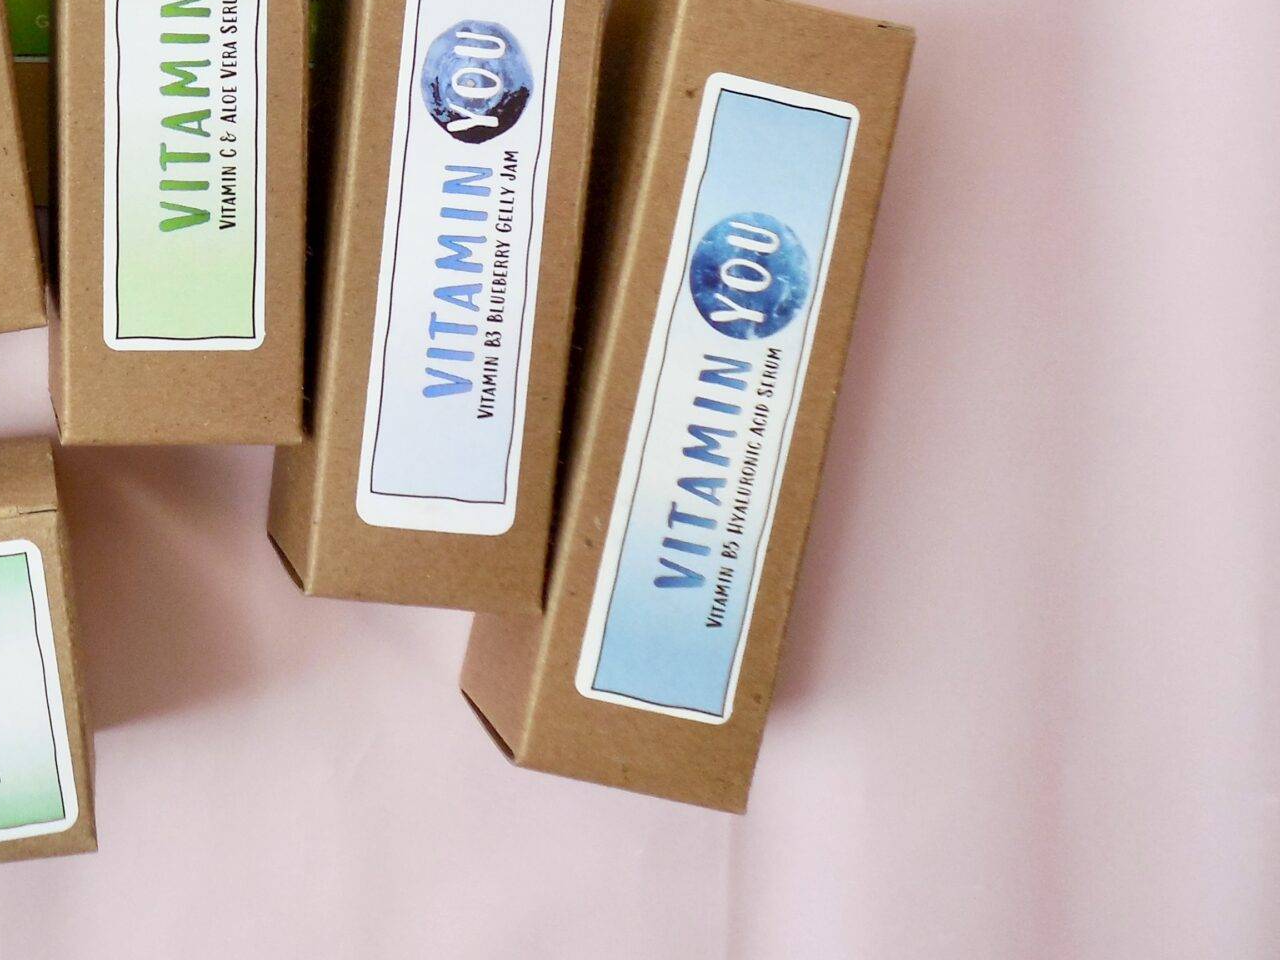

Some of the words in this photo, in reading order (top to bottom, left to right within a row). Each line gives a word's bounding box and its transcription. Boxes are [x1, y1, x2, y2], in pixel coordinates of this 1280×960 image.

[221, 40, 237, 79] VERA
[447, 32, 507, 132] YOU
[221, 84, 237, 124] ALOE
[220, 129, 236, 143] &
[220, 146, 237, 158] C
[499, 150, 519, 182] JAM
[219, 165, 237, 230] VITAMIN
[495, 186, 516, 232] GELLY
[422, 165, 493, 398] VITAMIN
[487, 238, 511, 323] BLUEBERRY
[484, 330, 501, 347] B3
[477, 355, 499, 419] VITAMIN
[757, 347, 782, 397] SERUM
[653, 354, 752, 588] VITAMIN
[709, 221, 781, 323] YOU
[752, 403, 769, 437] ACID
[728, 437, 761, 534] HYALURONIC
[721, 541, 740, 559] B5
[706, 564, 734, 628] VITAMIN
